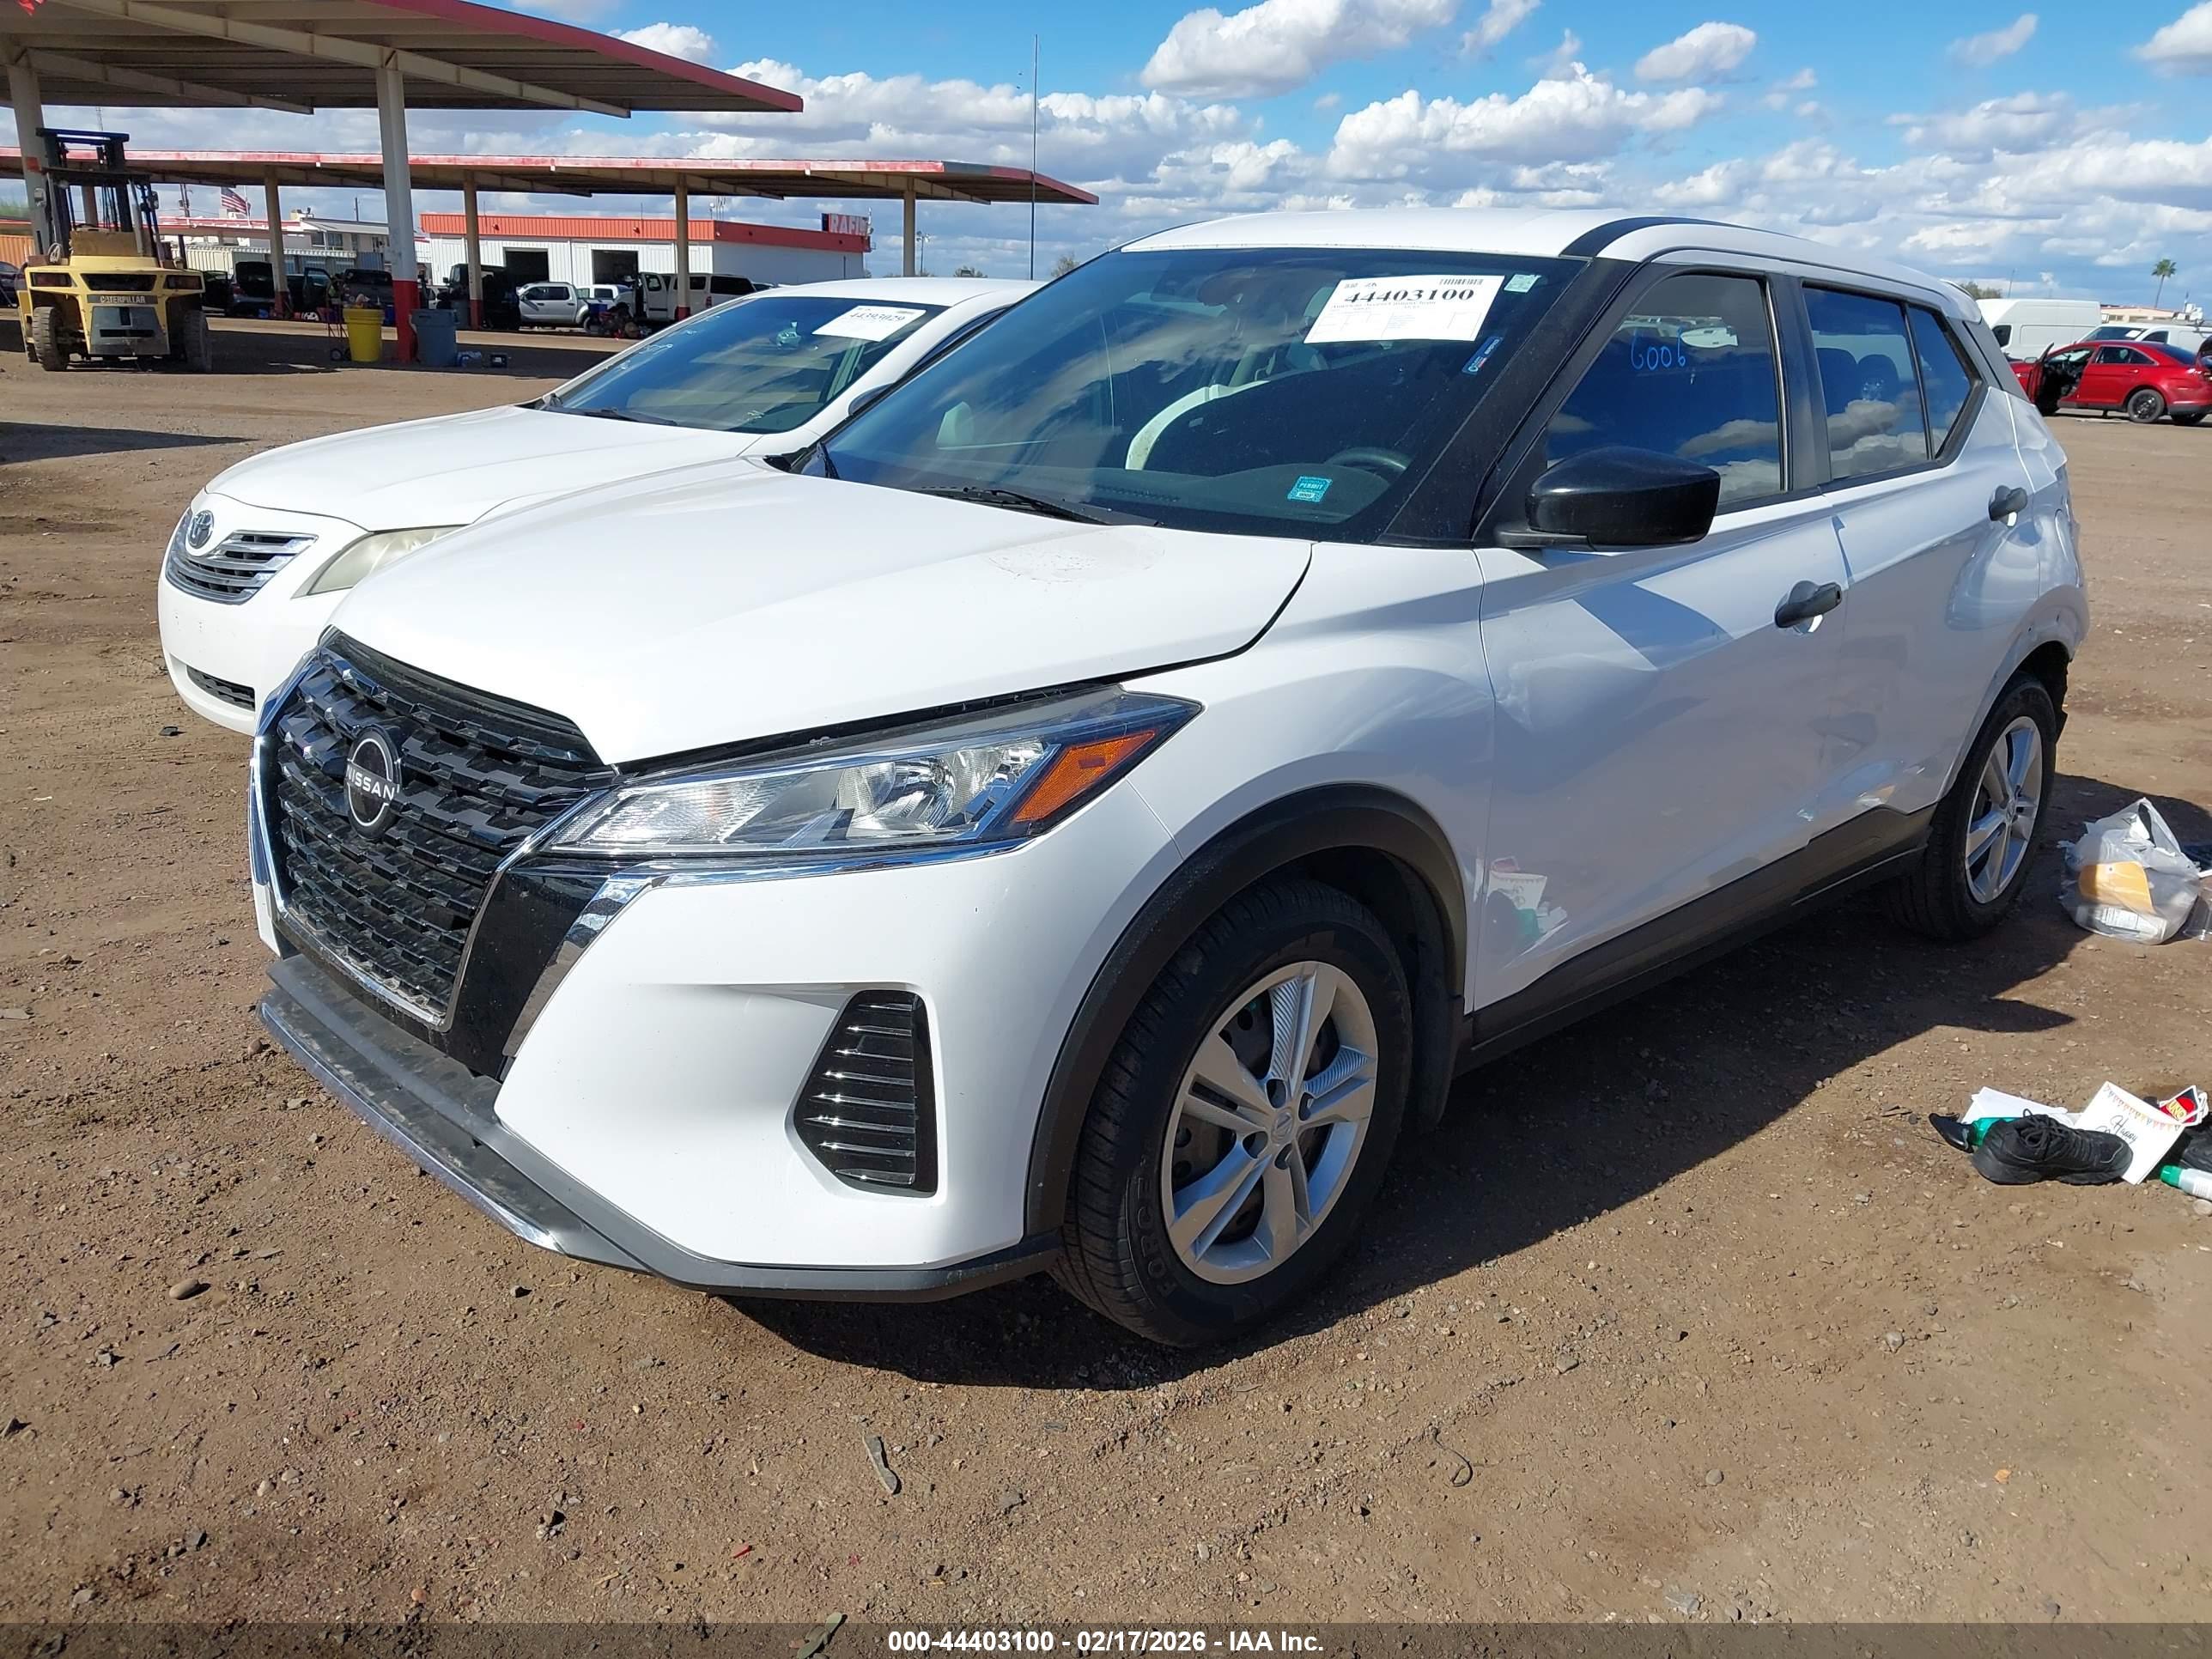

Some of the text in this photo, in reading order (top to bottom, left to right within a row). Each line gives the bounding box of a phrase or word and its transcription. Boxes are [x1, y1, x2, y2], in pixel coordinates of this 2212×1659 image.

[1344, 289, 1474, 303] 44403100
[346, 763, 395, 801] NISSAN
[2168, 1102, 2186, 1120] UNO
[2110, 1115, 2138, 1145] Happy
